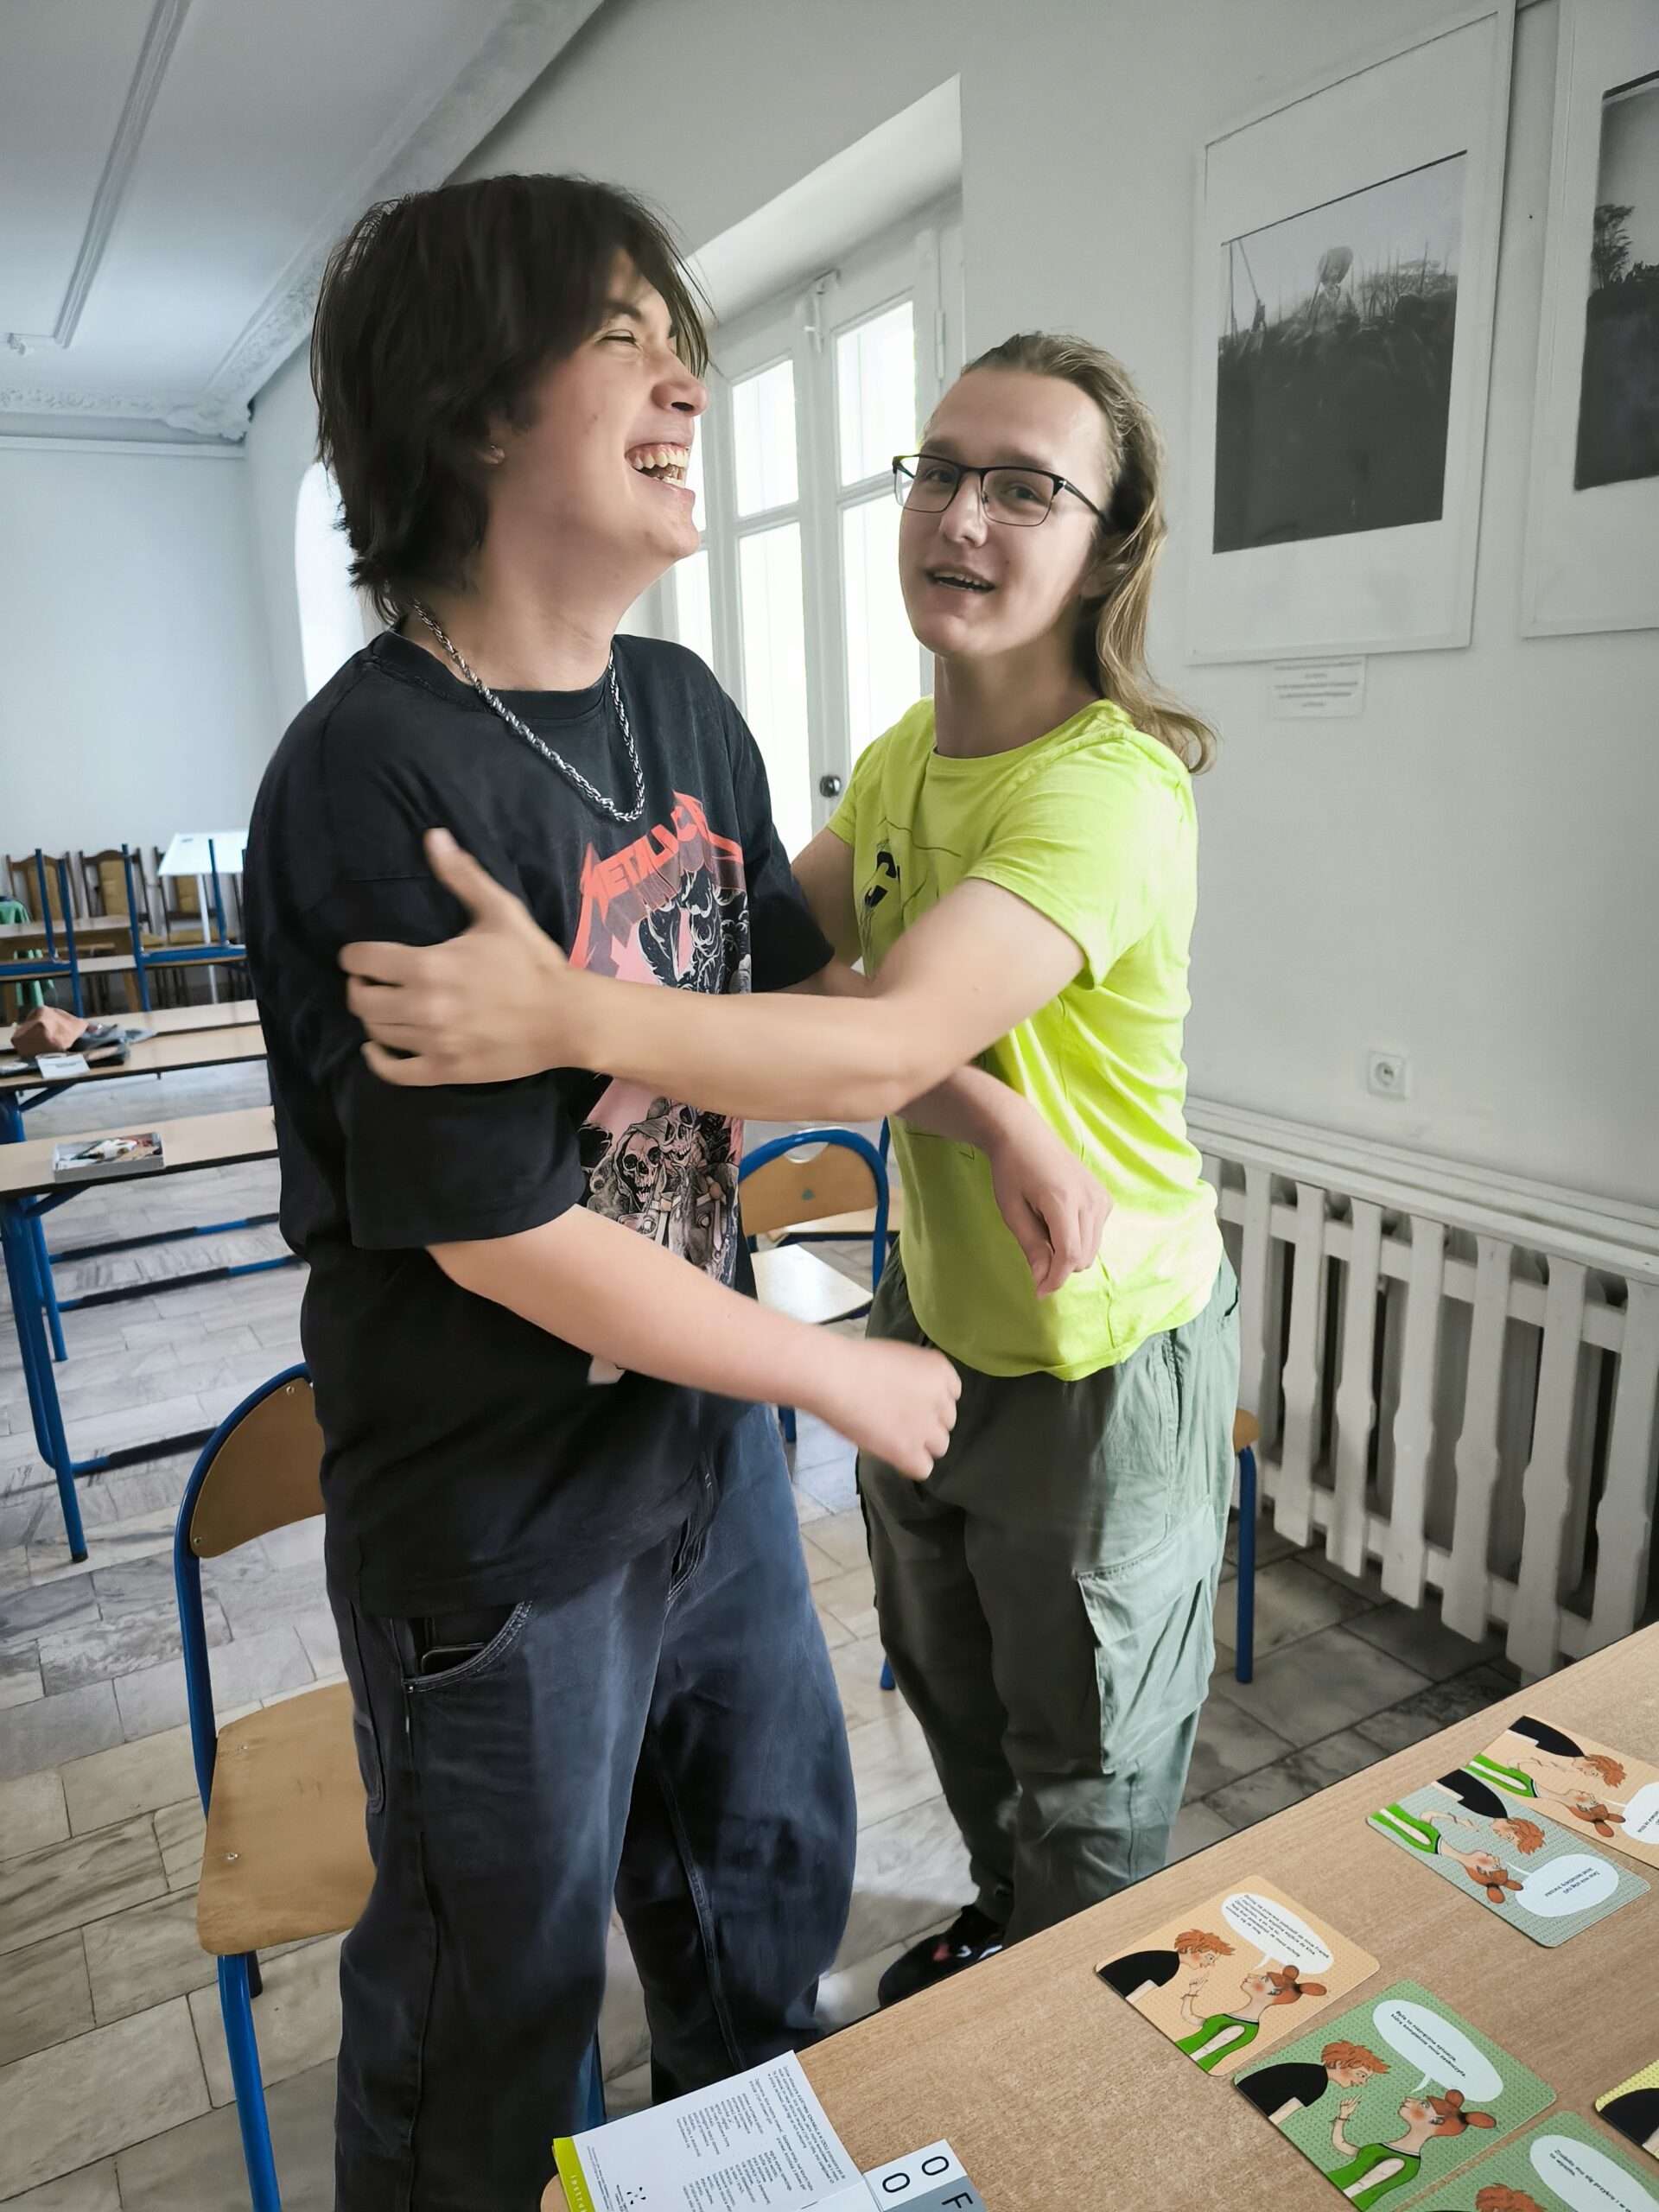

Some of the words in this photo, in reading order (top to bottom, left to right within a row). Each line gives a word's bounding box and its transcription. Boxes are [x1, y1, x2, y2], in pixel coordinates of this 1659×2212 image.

[569, 789, 744, 969] METALICA
[921, 2156, 949, 2176] O
[882, 2172, 910, 2193] O
[941, 2191, 973, 2209] F
